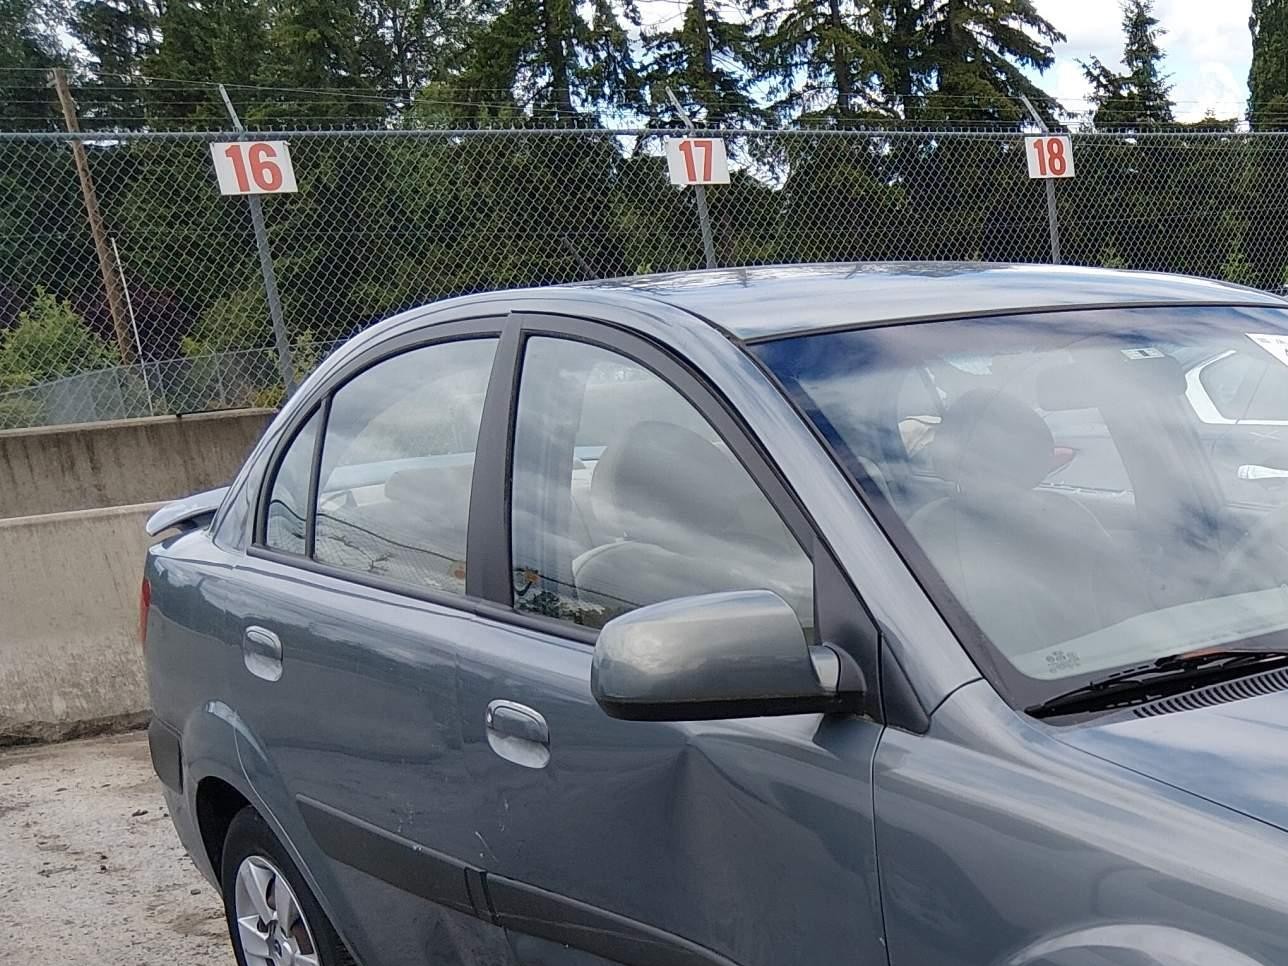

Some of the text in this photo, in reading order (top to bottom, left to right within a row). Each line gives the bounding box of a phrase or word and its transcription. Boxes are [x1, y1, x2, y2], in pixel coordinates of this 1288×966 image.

[224, 143, 281, 192] 16
[679, 140, 712, 182] 17
[1035, 137, 1067, 177] 18
